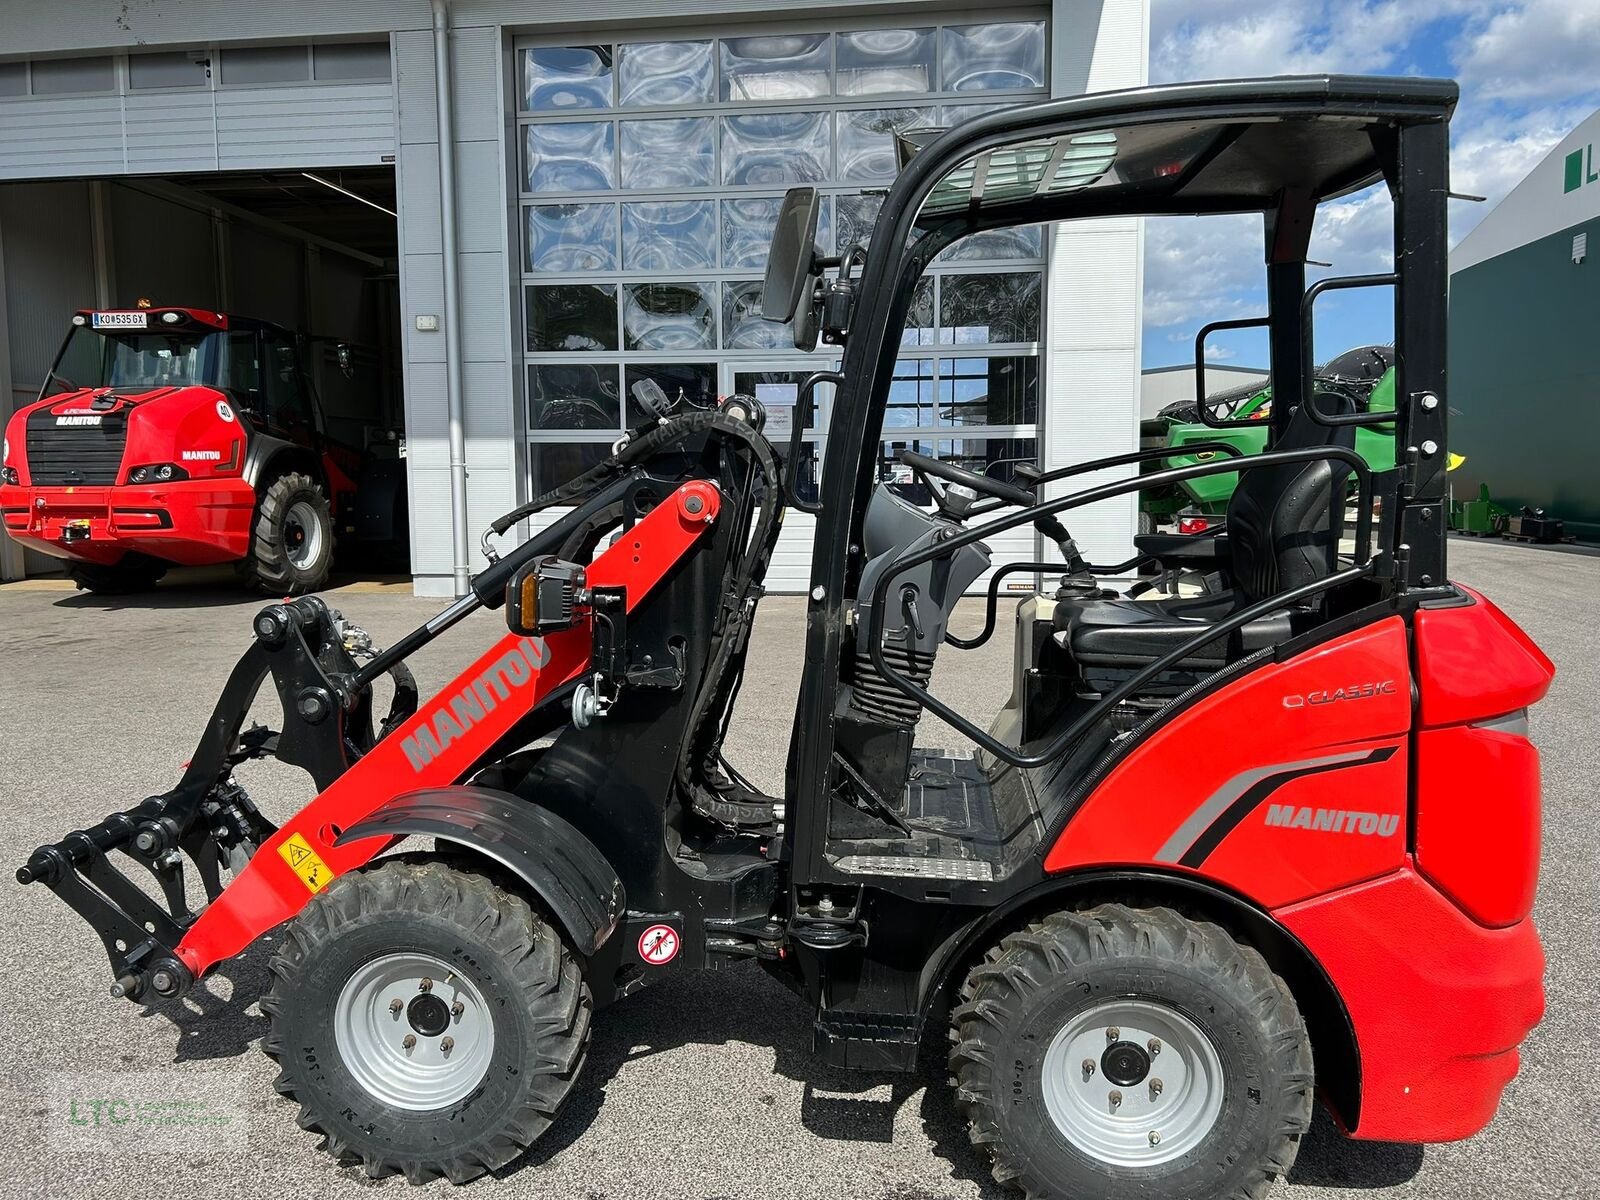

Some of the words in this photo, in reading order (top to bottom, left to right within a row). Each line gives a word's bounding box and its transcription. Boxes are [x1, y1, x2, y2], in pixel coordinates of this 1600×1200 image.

[100, 314, 110, 324] KO
[220, 404, 231, 418] 40
[56, 416, 102, 426] MANITOU
[182, 450, 221, 460] MANITOU
[1307, 680, 1396, 705] CLASSIC
[400, 638, 551, 773] MANITOU
[1264, 804, 1400, 837] MANITOU
